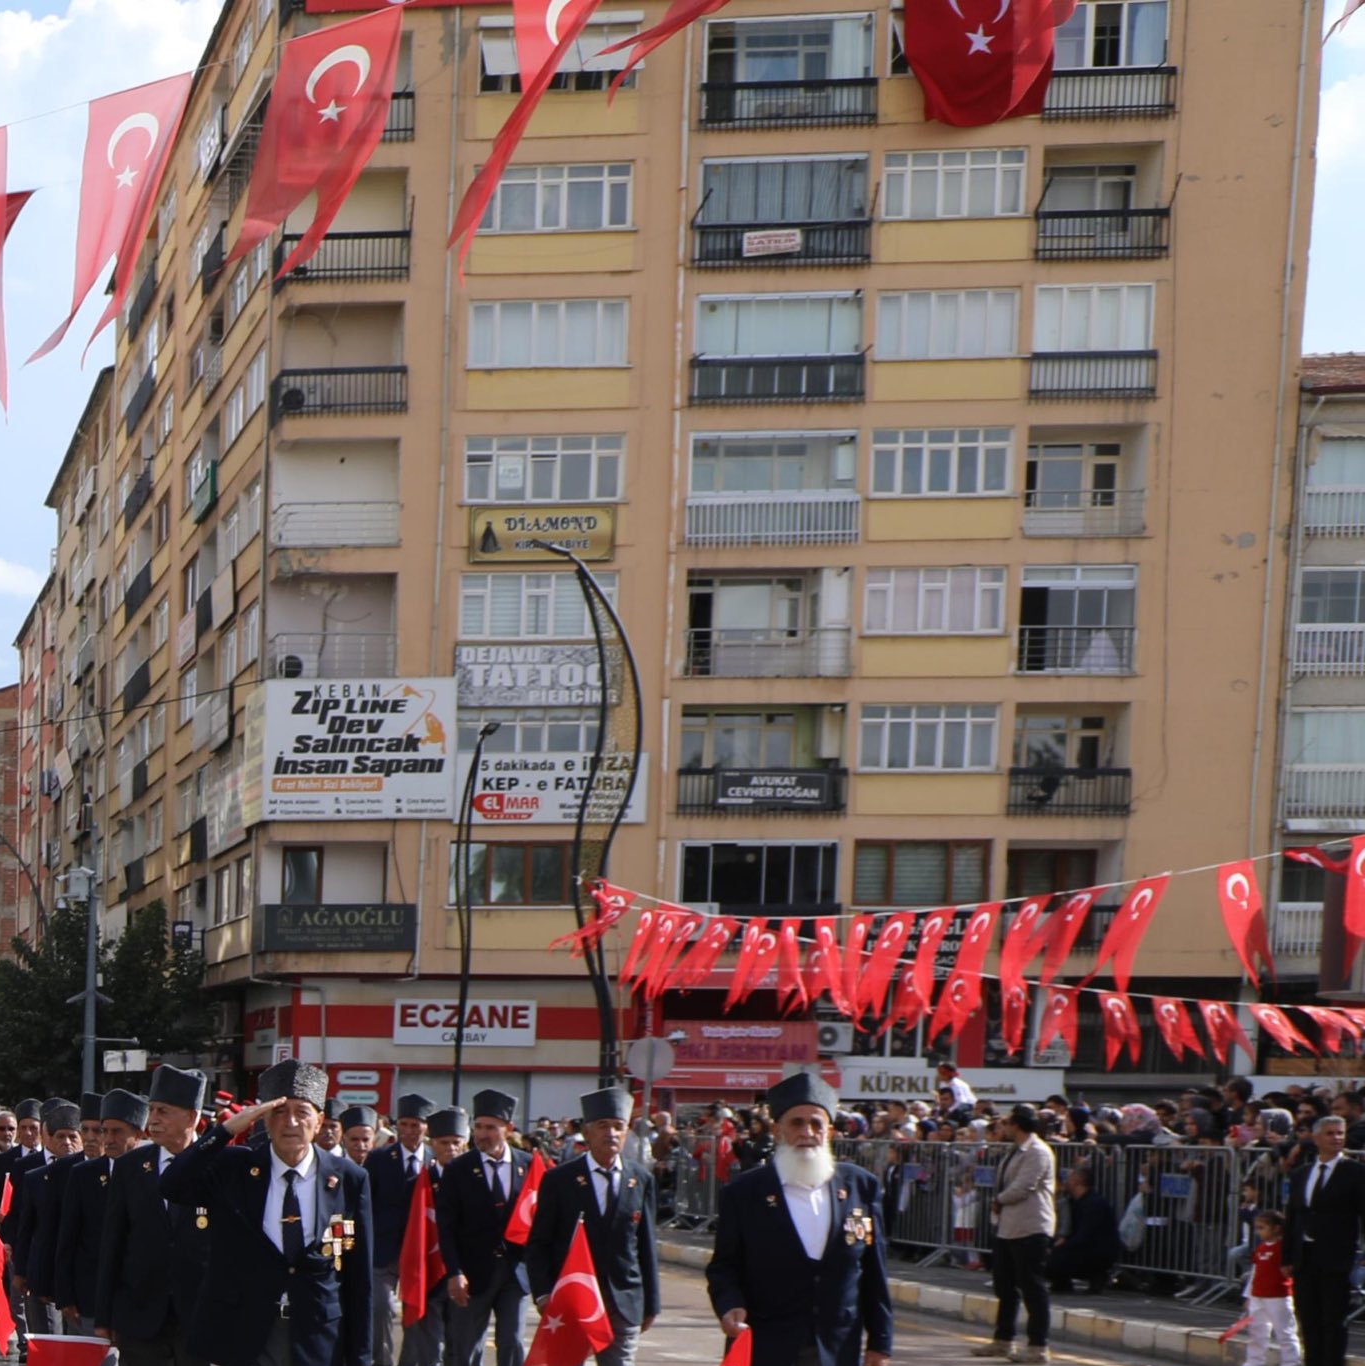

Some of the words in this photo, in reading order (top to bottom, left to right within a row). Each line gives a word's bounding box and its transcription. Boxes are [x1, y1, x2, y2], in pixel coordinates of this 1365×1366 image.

[461, 647, 542, 663] DEJAVU
[314, 684, 381, 698] KEBAN
[327, 715, 384, 735] Dev
[293, 734, 421, 753] Salıncak
[352, 756, 445, 777] Sapanı
[480, 760, 489, 771] 5
[494, 759, 555, 771] dakikada
[564, 759, 576, 771] e
[482, 777, 519, 791] KEP
[537, 779, 548, 791] e
[750, 776, 798, 786] AVUKAT
[727, 787, 774, 797] CEVHER
[776, 786, 820, 798] DOĞAN
[298, 907, 404, 926] AĞAOĞLU
[399, 1003, 530, 1029] ECZANE
